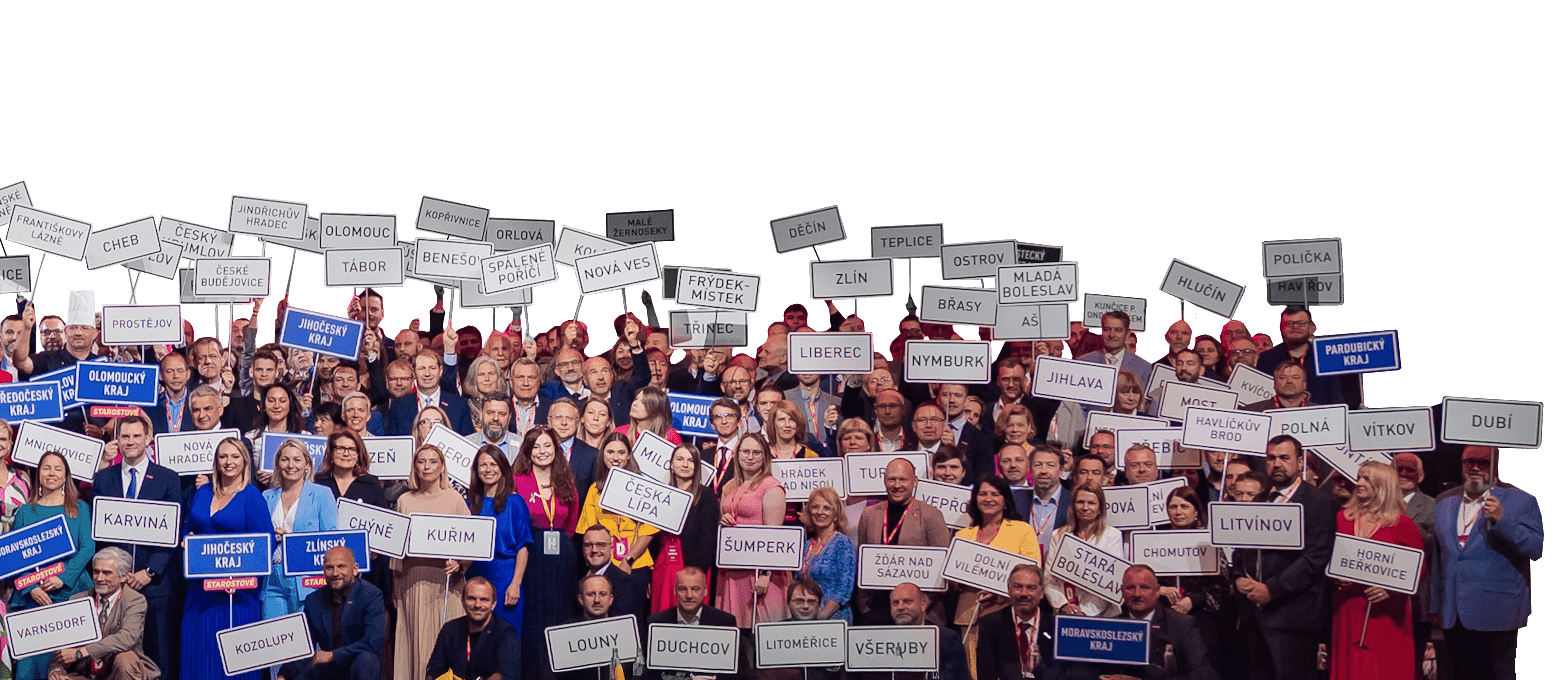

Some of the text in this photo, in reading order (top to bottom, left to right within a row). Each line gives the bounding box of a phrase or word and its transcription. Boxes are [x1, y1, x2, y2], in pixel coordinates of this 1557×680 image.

[237, 205, 299, 220] JINDŘICHŮV
[425, 209, 480, 228] KOPŘIVNICE
[16, 214, 84, 240] FRANTIŠKOVY
[246, 217, 288, 230] HRADEC
[628, 218, 652, 227] MALÉ
[175, 224, 217, 242] ČESKÝ
[325, 226, 390, 238] OLOMOUC
[496, 228, 543, 241] ORLOVÁ
[613, 226, 667, 237] ŽERNOSEKY
[789, 222, 826, 238] DĚČÍN
[31, 230, 63, 246] LÁZNĚ
[103, 234, 138, 252] CHEB
[881, 236, 933, 247] TEPLICE
[489, 252, 546, 272] SPÁLENÉ
[954, 253, 1004, 266] OSTROV
[1274, 250, 1332, 265] POLIČKA
[216, 265, 249, 276] ČESKÉ
[342, 259, 386, 272] TÁBOR
[585, 257, 650, 279] NOVÁ VES
[201, 276, 263, 287] BUDĚJOVICE
[498, 265, 541, 284] POŘÍČÍ
[836, 270, 867, 284] ZLÍN
[1014, 268, 1062, 282] MLADÁ
[688, 275, 750, 290] FRÝDEK-
[1177, 275, 1226, 302] HLUČÍN
[691, 287, 743, 304] MÍSTEK
[1004, 284, 1073, 297] BOLESLAV
[938, 298, 982, 312] BŘASY
[112, 316, 173, 329] PROSTĚJOV
[298, 318, 348, 335] JIHOČESKÝ
[1022, 313, 1038, 326] AŠ
[684, 321, 734, 333] TŘINEC
[801, 346, 861, 358] LIBEREC
[1325, 340, 1384, 355] PARDUBICKÝ
[912, 355, 984, 367] NYMBURK
[89, 370, 146, 383] OLOMOUCKÝ
[1046, 372, 1103, 389] JIHLAVA
[104, 384, 129, 396] KRAJ
[10, 404, 35, 416] KRAJ
[1196, 416, 1260, 431] HAVLÍČKŮV
[1281, 418, 1329, 434] POLNÁ
[1472, 415, 1512, 429] DUBÍ
[1211, 430, 1242, 442] BROD
[1363, 423, 1415, 436] VÍTKOV
[25, 439, 92, 464] MNICHOVICE
[625, 478, 672, 506] ČESKÁ
[628, 496, 659, 517] LÍPA
[104, 512, 168, 529] KARVINÁ
[1221, 518, 1292, 531] LITVÍNOV
[427, 528, 475, 543] KUŘIM
[201, 541, 255, 555] JIHOČESKÝ
[724, 537, 796, 553] ŠUMPERK
[1143, 546, 1207, 558] CHOMUTOV
[215, 556, 241, 568] KRAJ
[875, 553, 933, 566] ŽĎÁR NAD
[1357, 548, 1394, 563] HORNÍ
[17, 564, 63, 588] STAROSTOVÉ
[877, 566, 929, 579] SÁZAVOU
[1340, 557, 1406, 581] BEŘKOVICE
[207, 579, 255, 588] STAROSTOVÉ
[17, 617, 86, 639] VARNSDORF
[1061, 627, 1143, 642] MORAVSKOSLEZSKÝ
[235, 633, 294, 655] KOZOLUPY
[569, 634, 619, 652] LOUNY
[657, 640, 729, 655] DUCHCOV
[766, 637, 837, 649] LITOMĚŘICE
